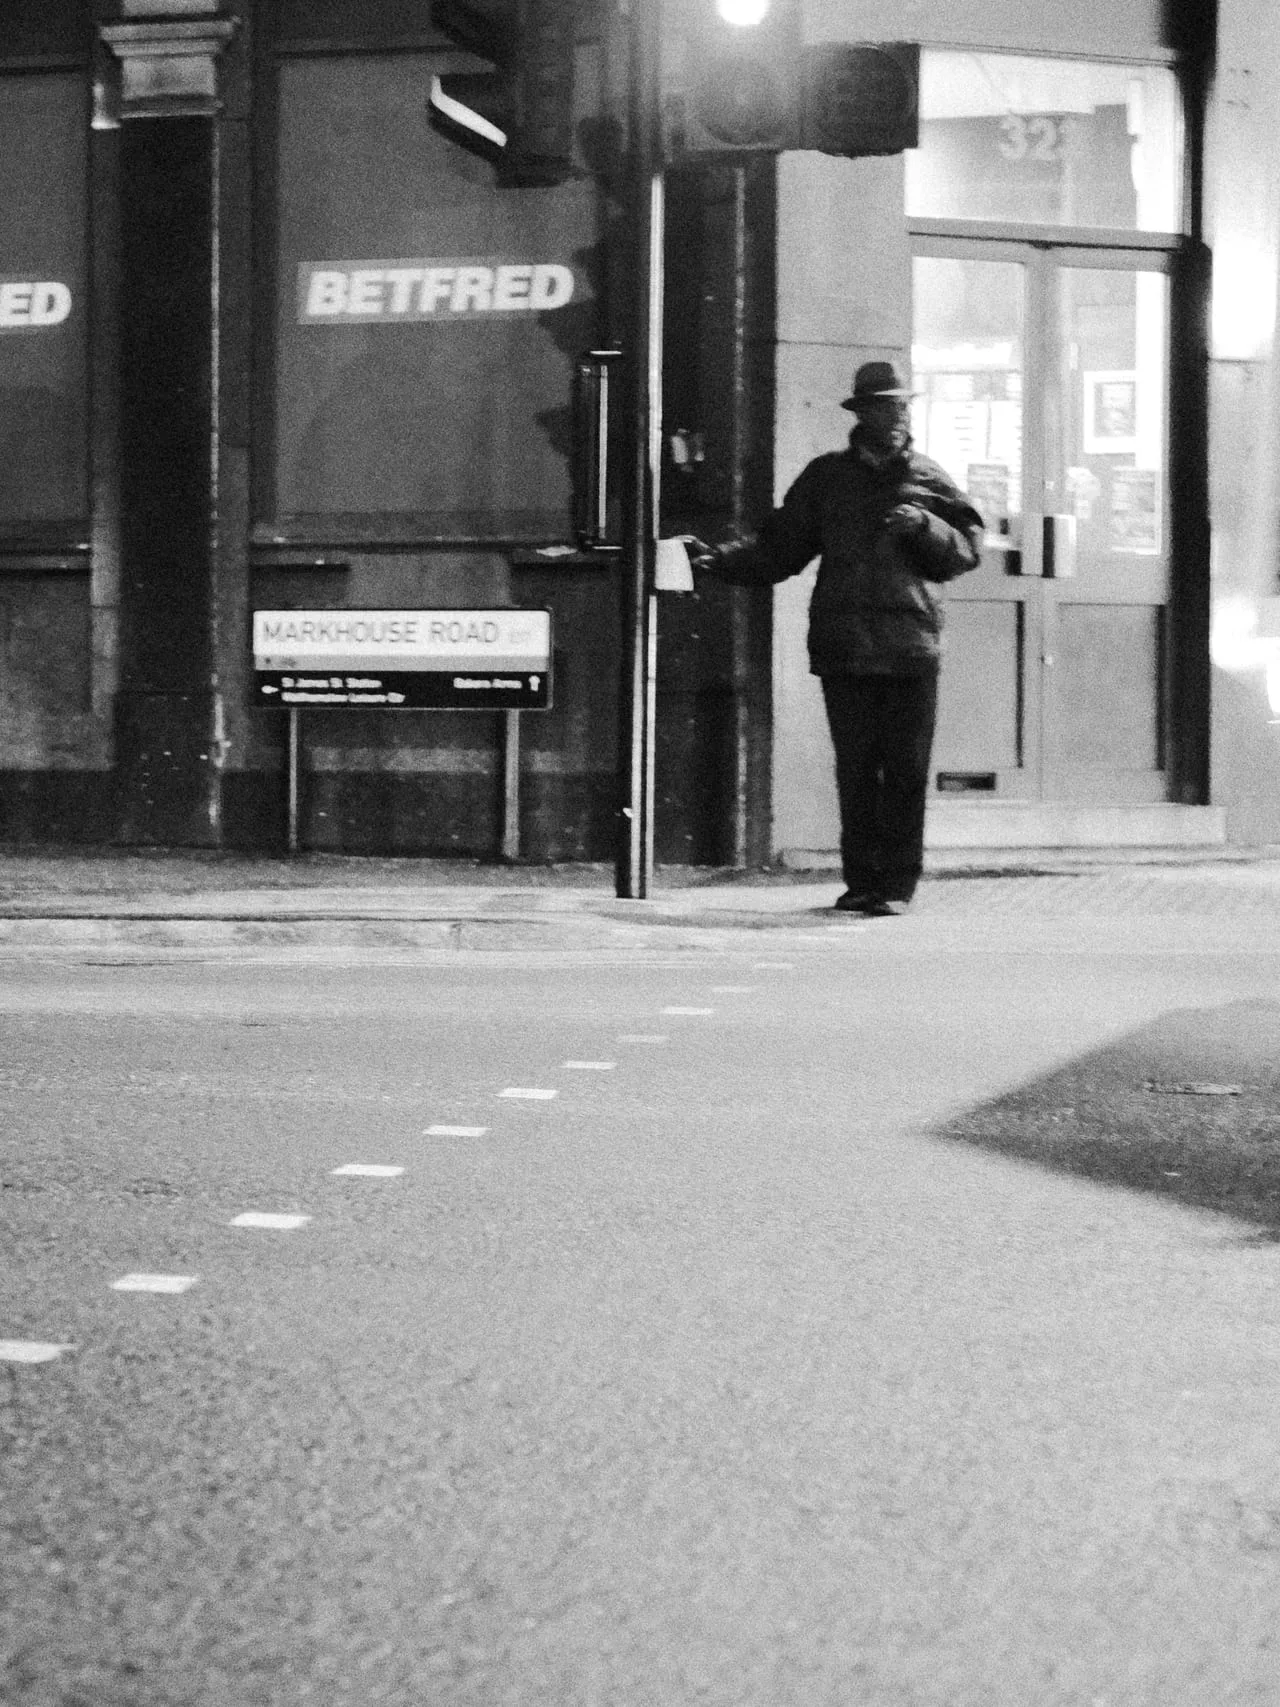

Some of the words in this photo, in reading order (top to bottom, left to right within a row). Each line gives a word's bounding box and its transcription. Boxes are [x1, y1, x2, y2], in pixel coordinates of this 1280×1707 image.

[306, 263, 574, 316] BETFRED
[262, 620, 418, 644] MARKHOUSE
[429, 620, 500, 644] ROAD
